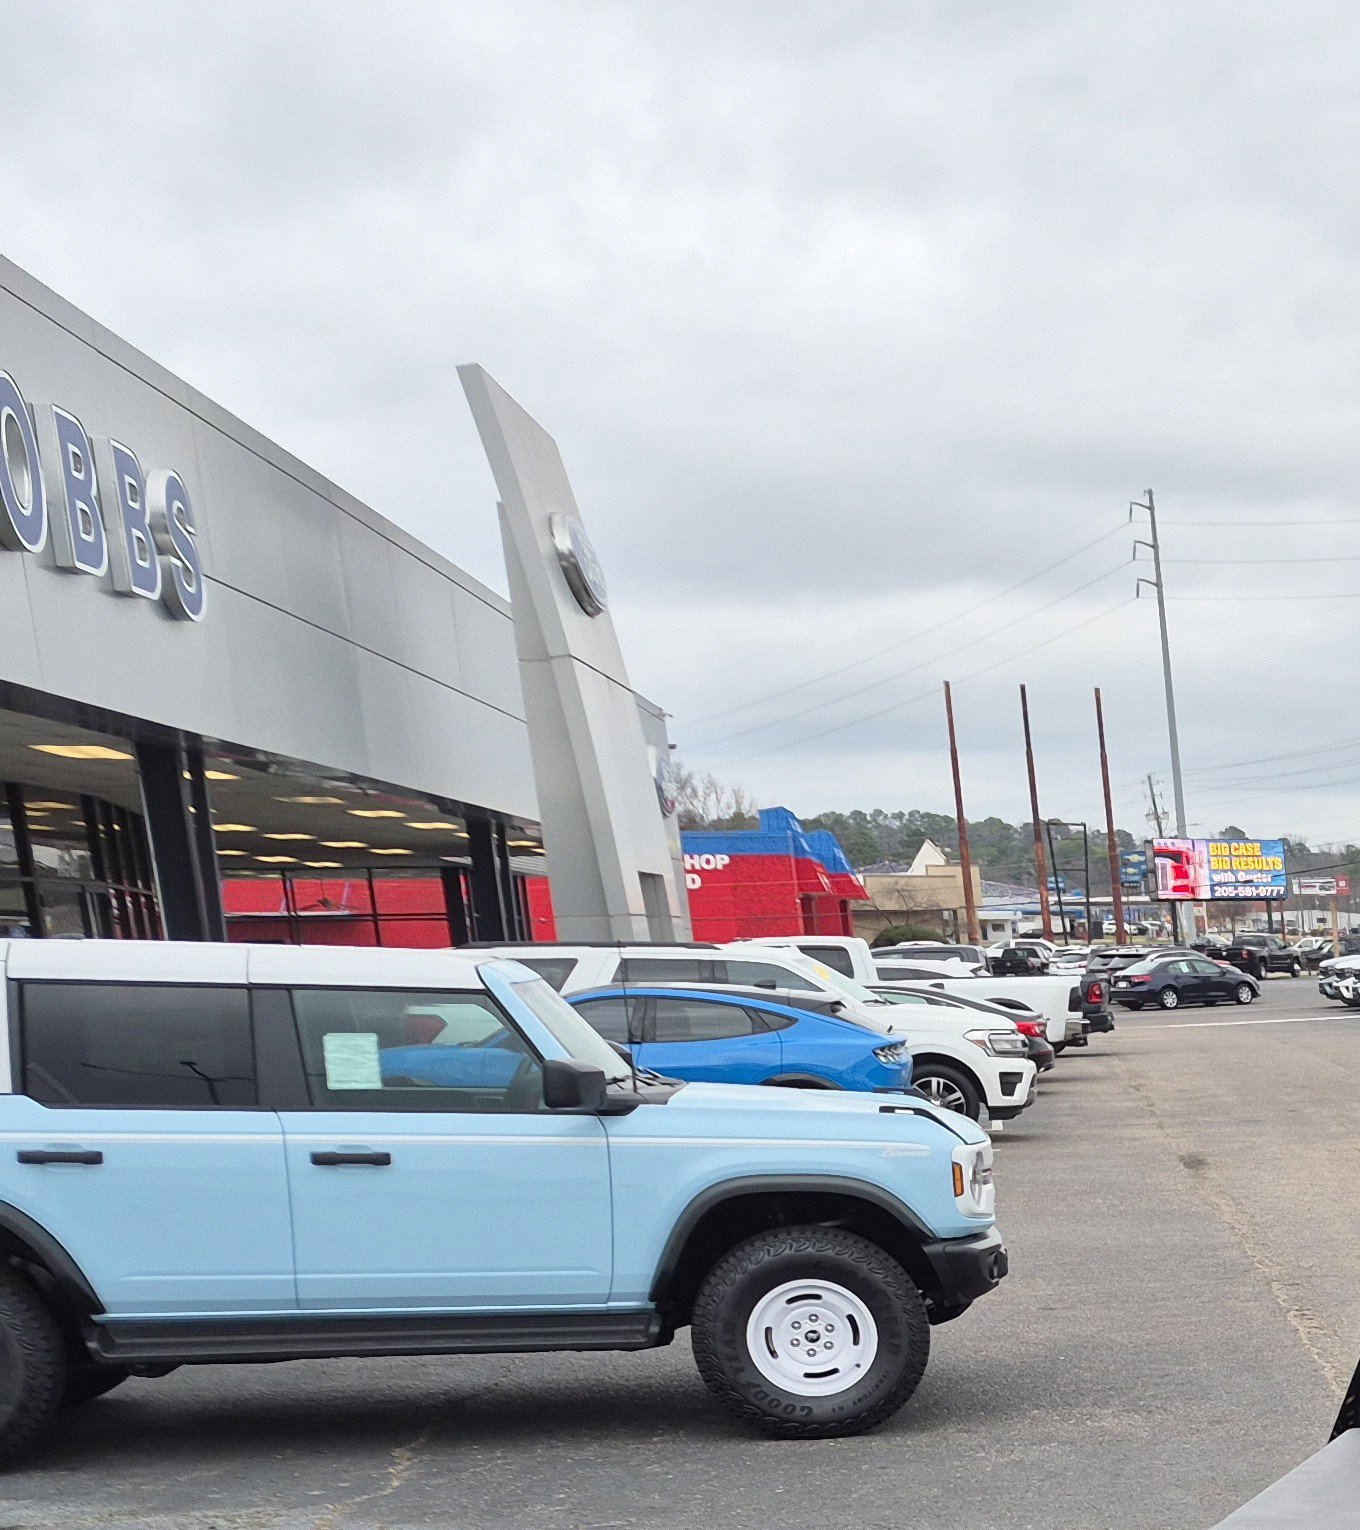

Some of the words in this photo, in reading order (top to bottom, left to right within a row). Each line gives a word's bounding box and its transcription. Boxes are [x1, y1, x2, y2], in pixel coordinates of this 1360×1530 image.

[1209, 842, 1230, 855] BIG
[1231, 842, 1261, 855] CASE
[1210, 857, 1231, 870] BIG
[1232, 858, 1283, 870] RESULTS
[1213, 871, 1235, 882] with
